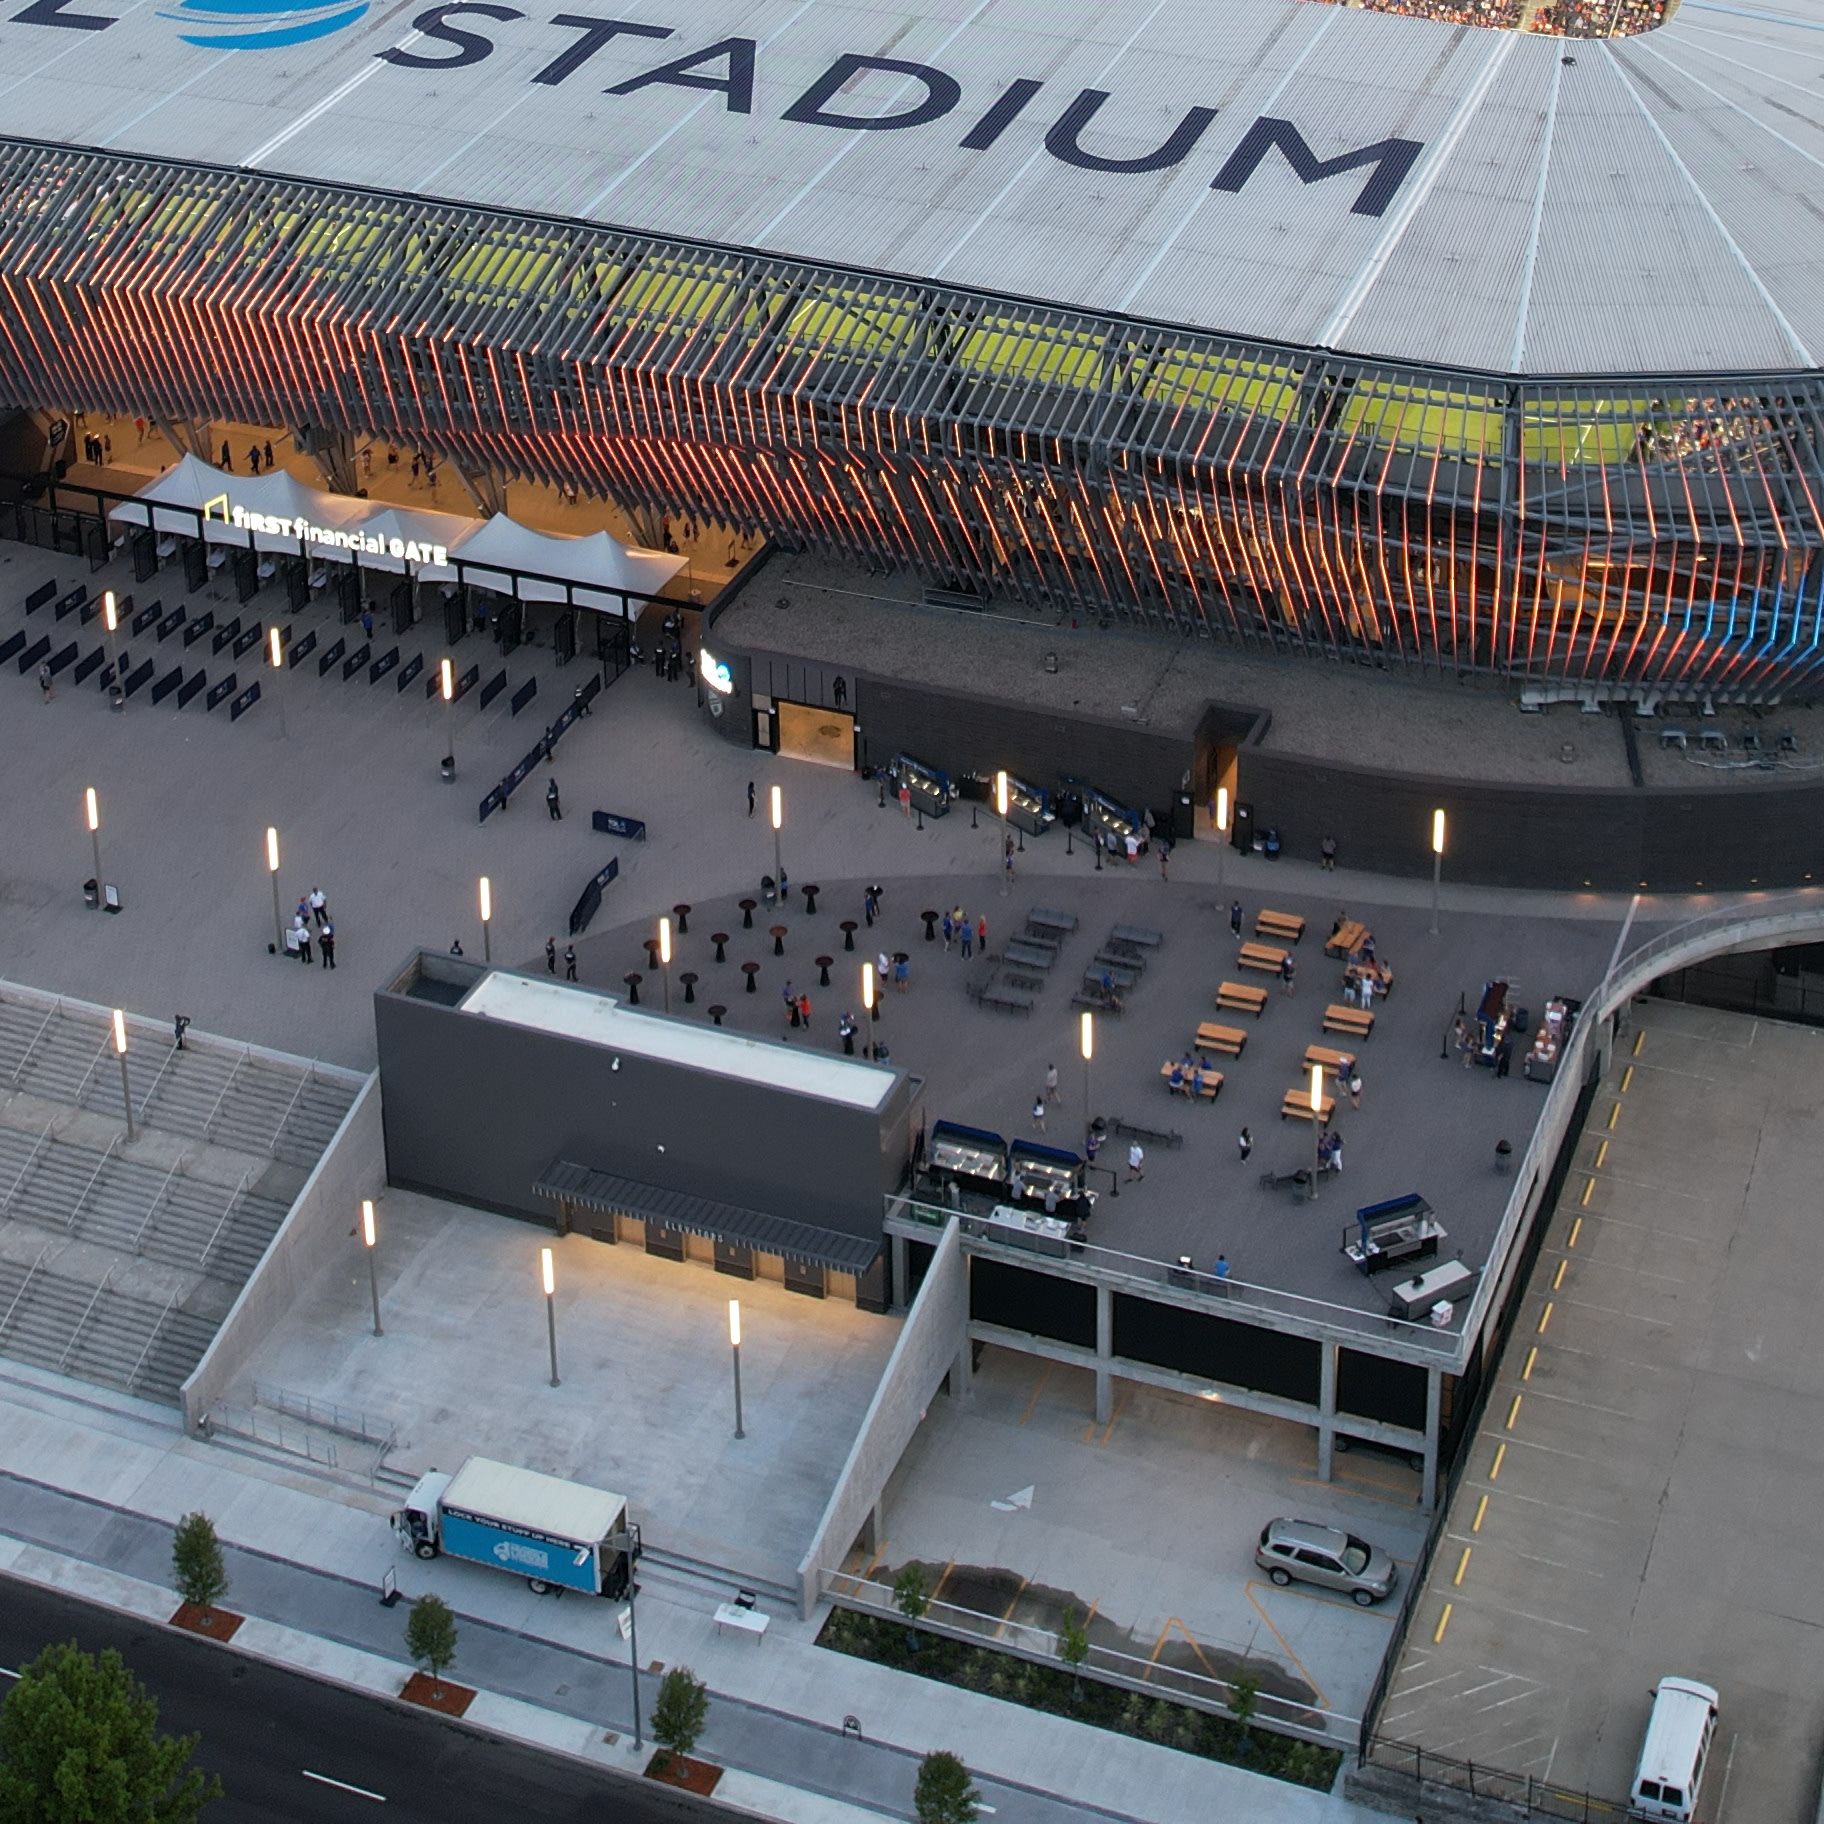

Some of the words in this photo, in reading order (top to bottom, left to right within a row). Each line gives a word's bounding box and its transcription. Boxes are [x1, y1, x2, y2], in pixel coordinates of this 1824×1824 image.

[375, 1, 1425, 218] STADIUM
[293, 516, 385, 555] financial
[389, 538, 448, 567] GATE
[665, 1219, 724, 1243] ELEVATORS
[448, 1508, 473, 1521] LOCK
[475, 1515, 500, 1529] YOUR
[531, 1532, 545, 1541] UP
